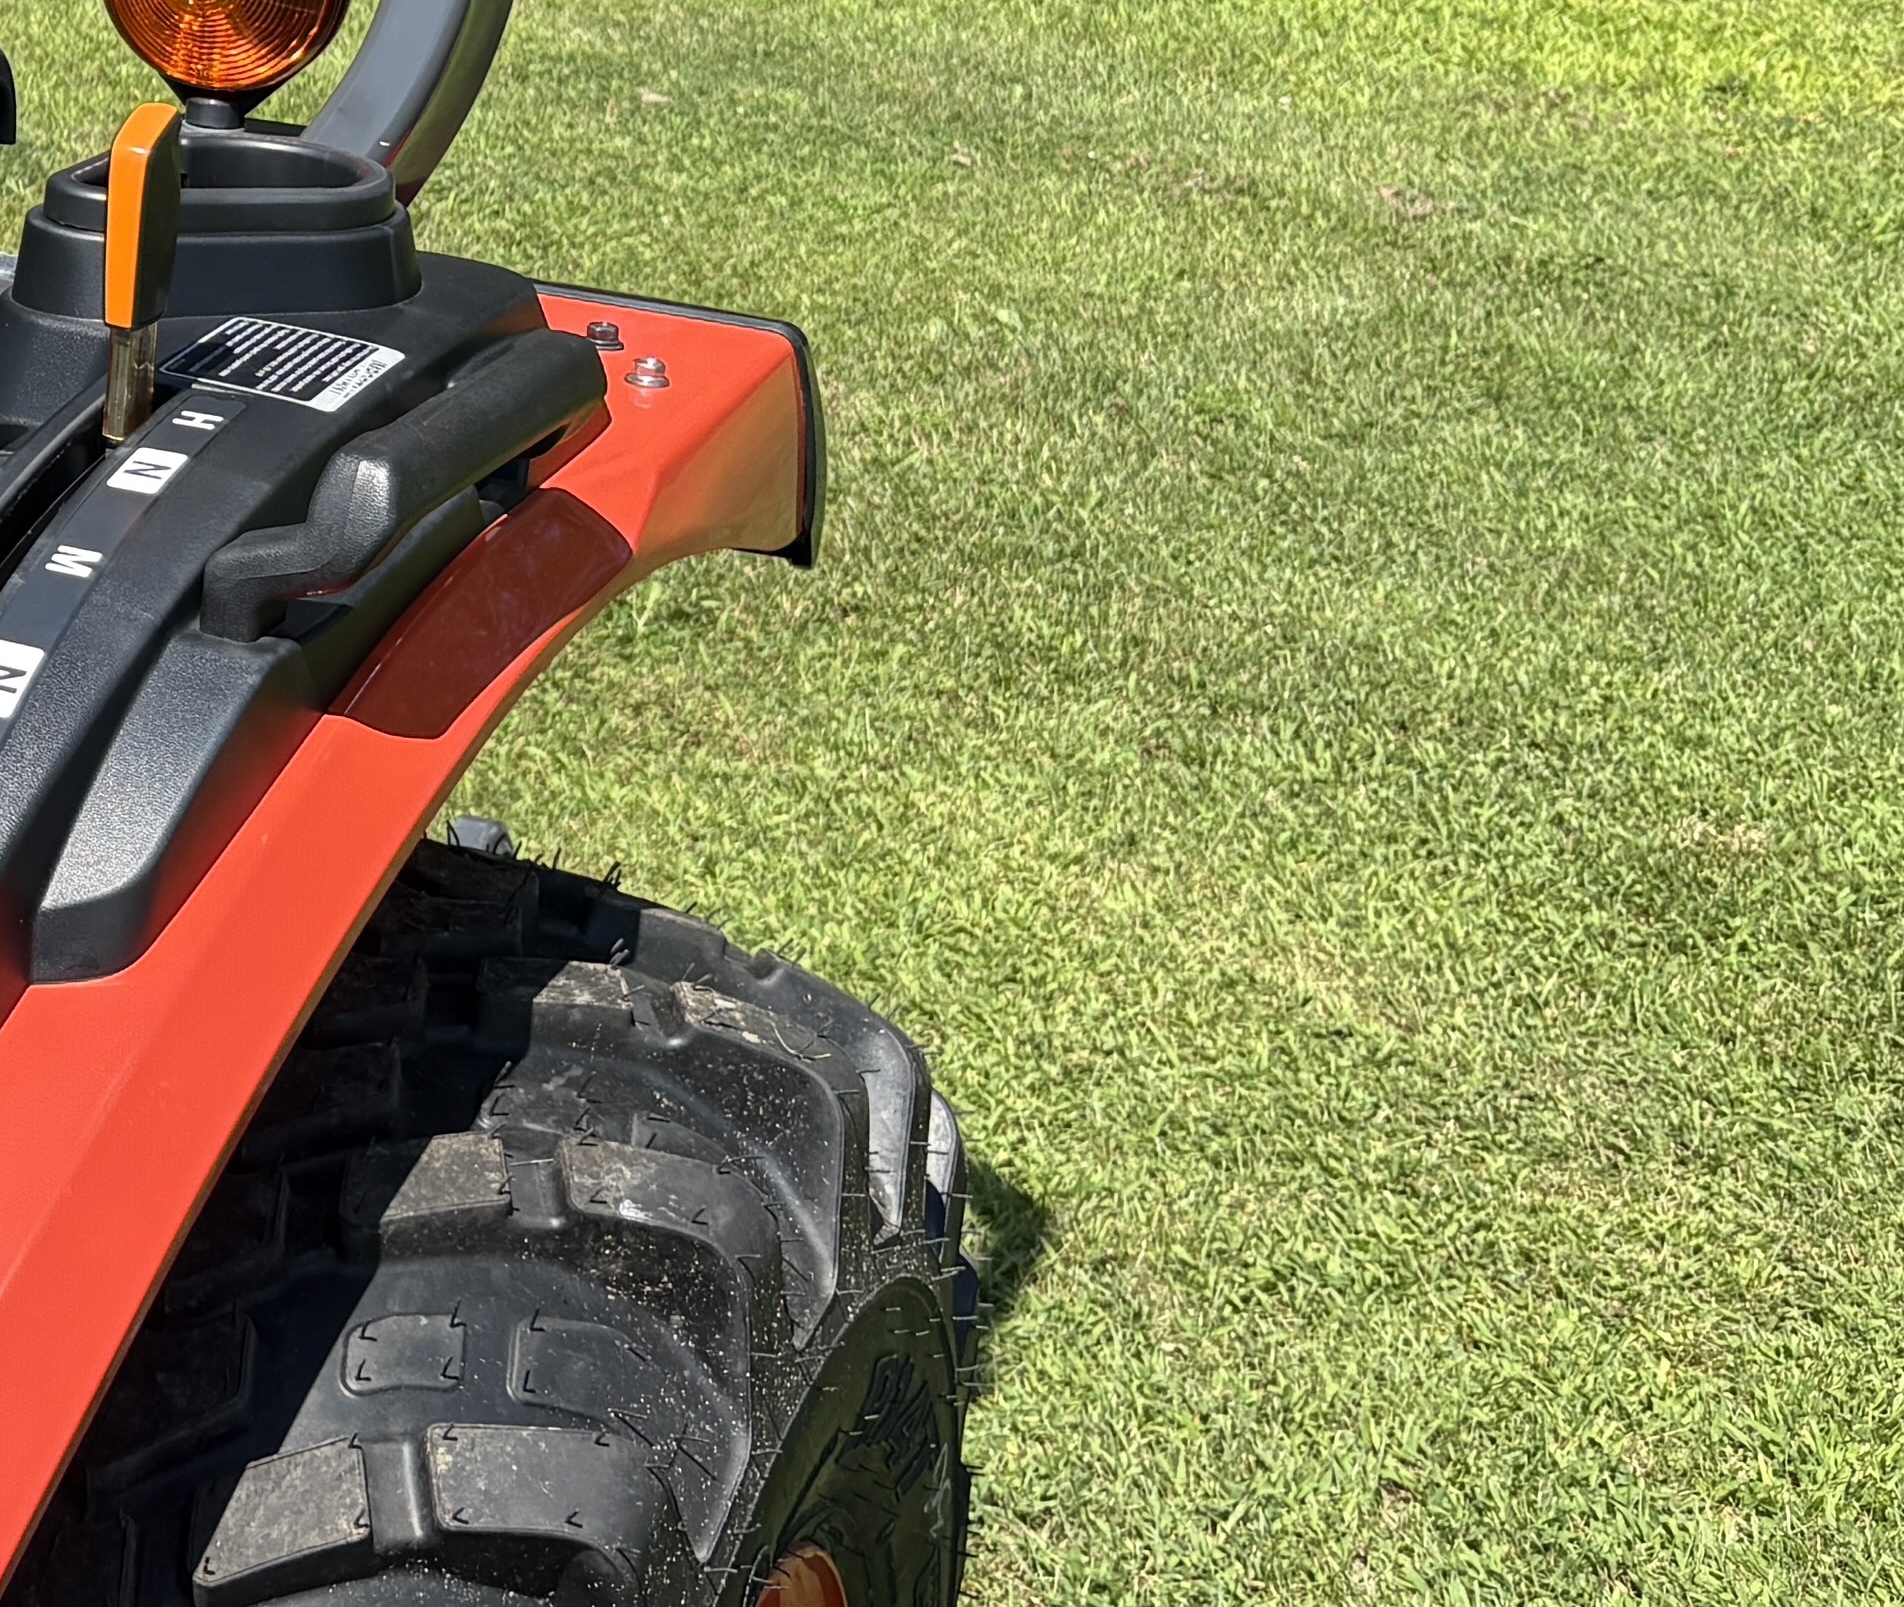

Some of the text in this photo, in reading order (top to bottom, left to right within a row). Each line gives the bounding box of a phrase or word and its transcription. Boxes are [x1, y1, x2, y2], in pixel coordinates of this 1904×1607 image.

[172, 409, 225, 431] H
[123, 459, 173, 482] N
[44, 544, 104, 578] M
